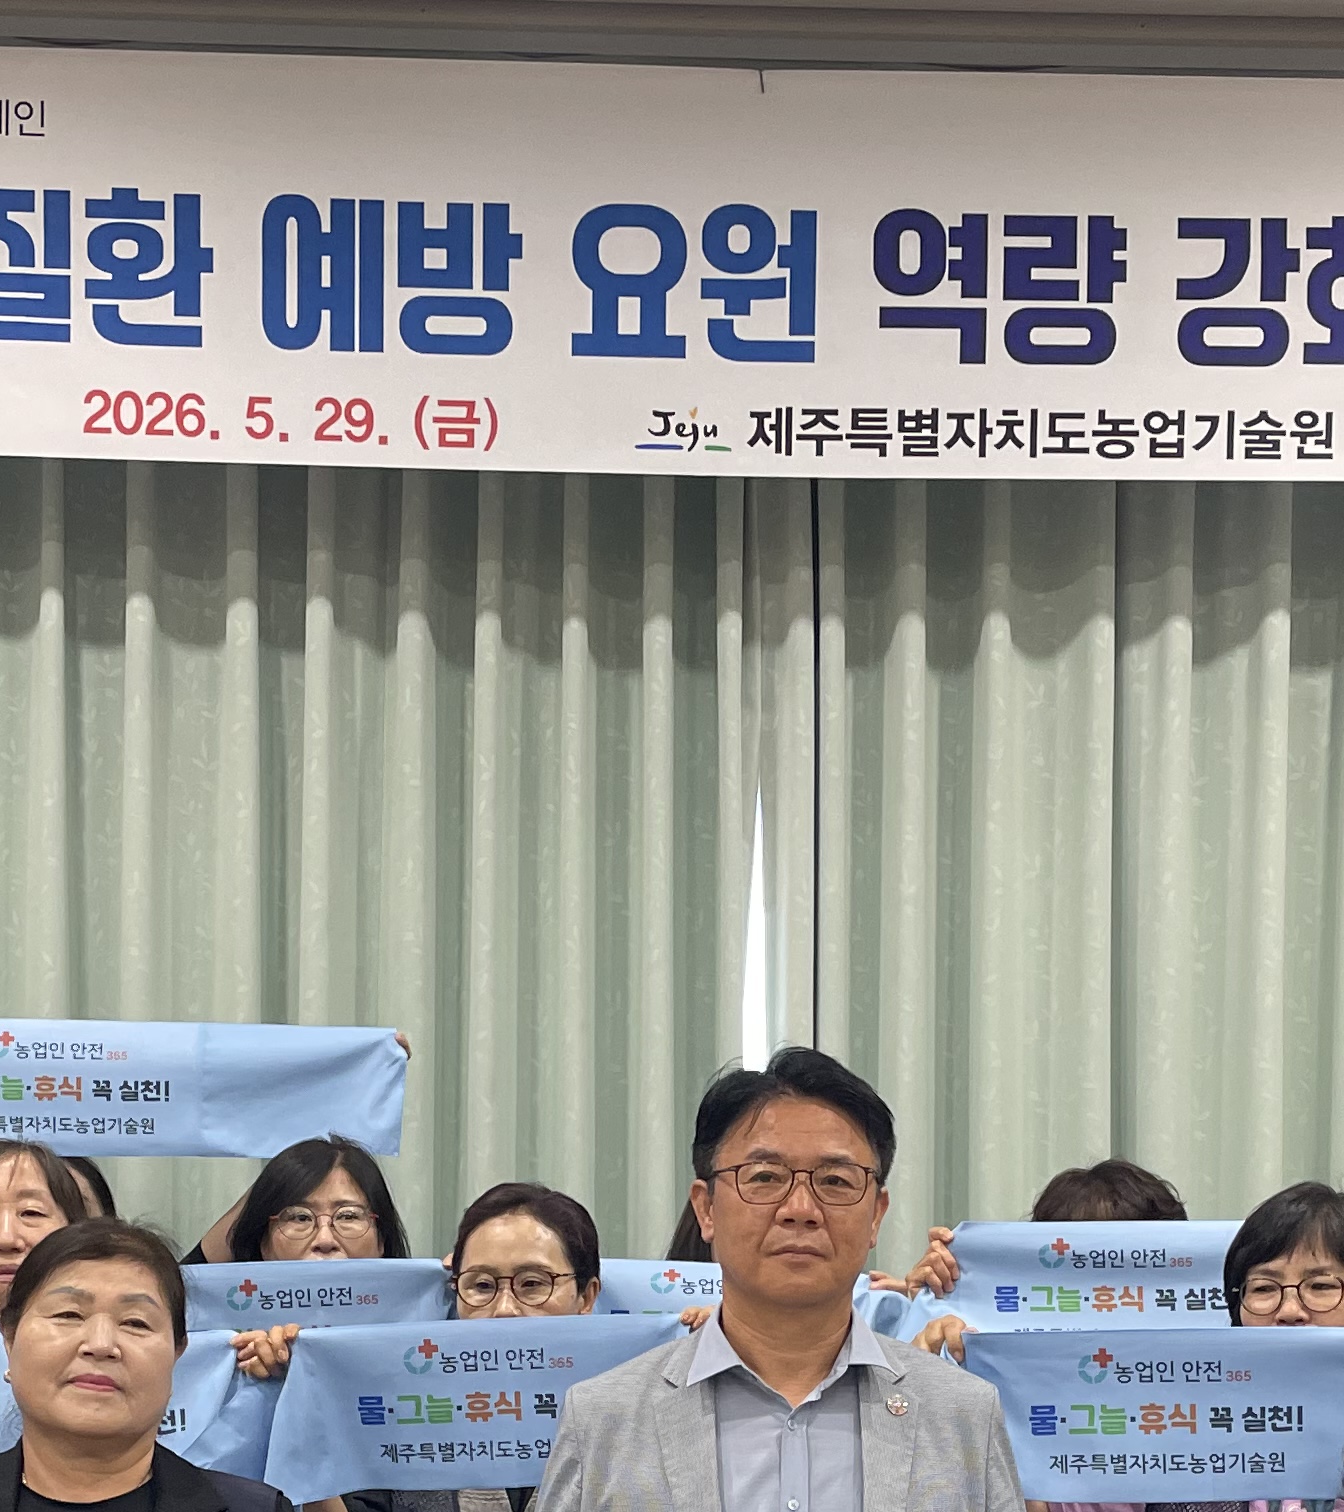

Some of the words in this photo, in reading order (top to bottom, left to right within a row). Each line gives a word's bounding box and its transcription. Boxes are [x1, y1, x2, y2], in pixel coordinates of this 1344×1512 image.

[261, 192, 523, 357] 예방
[571, 203, 816, 364] 요원
[872, 207, 1128, 367] 역량
[83, 389, 219, 441] 2026.
[245, 396, 299, 440] 5.
[314, 397, 389, 445] 29.
[413, 397, 499, 451] (금)
[648, 407, 718, 452] Jeju
[747, 405, 1336, 462] 제주특별자치도농업기술원
[14, 1040, 65, 1060] 농업인
[91, 1078, 113, 1101] 꼭
[119, 1079, 169, 1103] 실천!
[1070, 1249, 1124, 1269] 농업인
[258, 1288, 311, 1310] 농업인
[1155, 1288, 1177, 1311] 꼭
[439, 1349, 498, 1373] 농업인
[1114, 1361, 1175, 1384] 농업인
[534, 1393, 557, 1418] 꼭
[1209, 1407, 1234, 1432] 꼭
[1241, 1406, 1303, 1433] 실천!
[381, 1439, 551, 1463] 제주특별자치도농업
[1049, 1453, 1286, 1475] 제주특별자치도농업기술원
